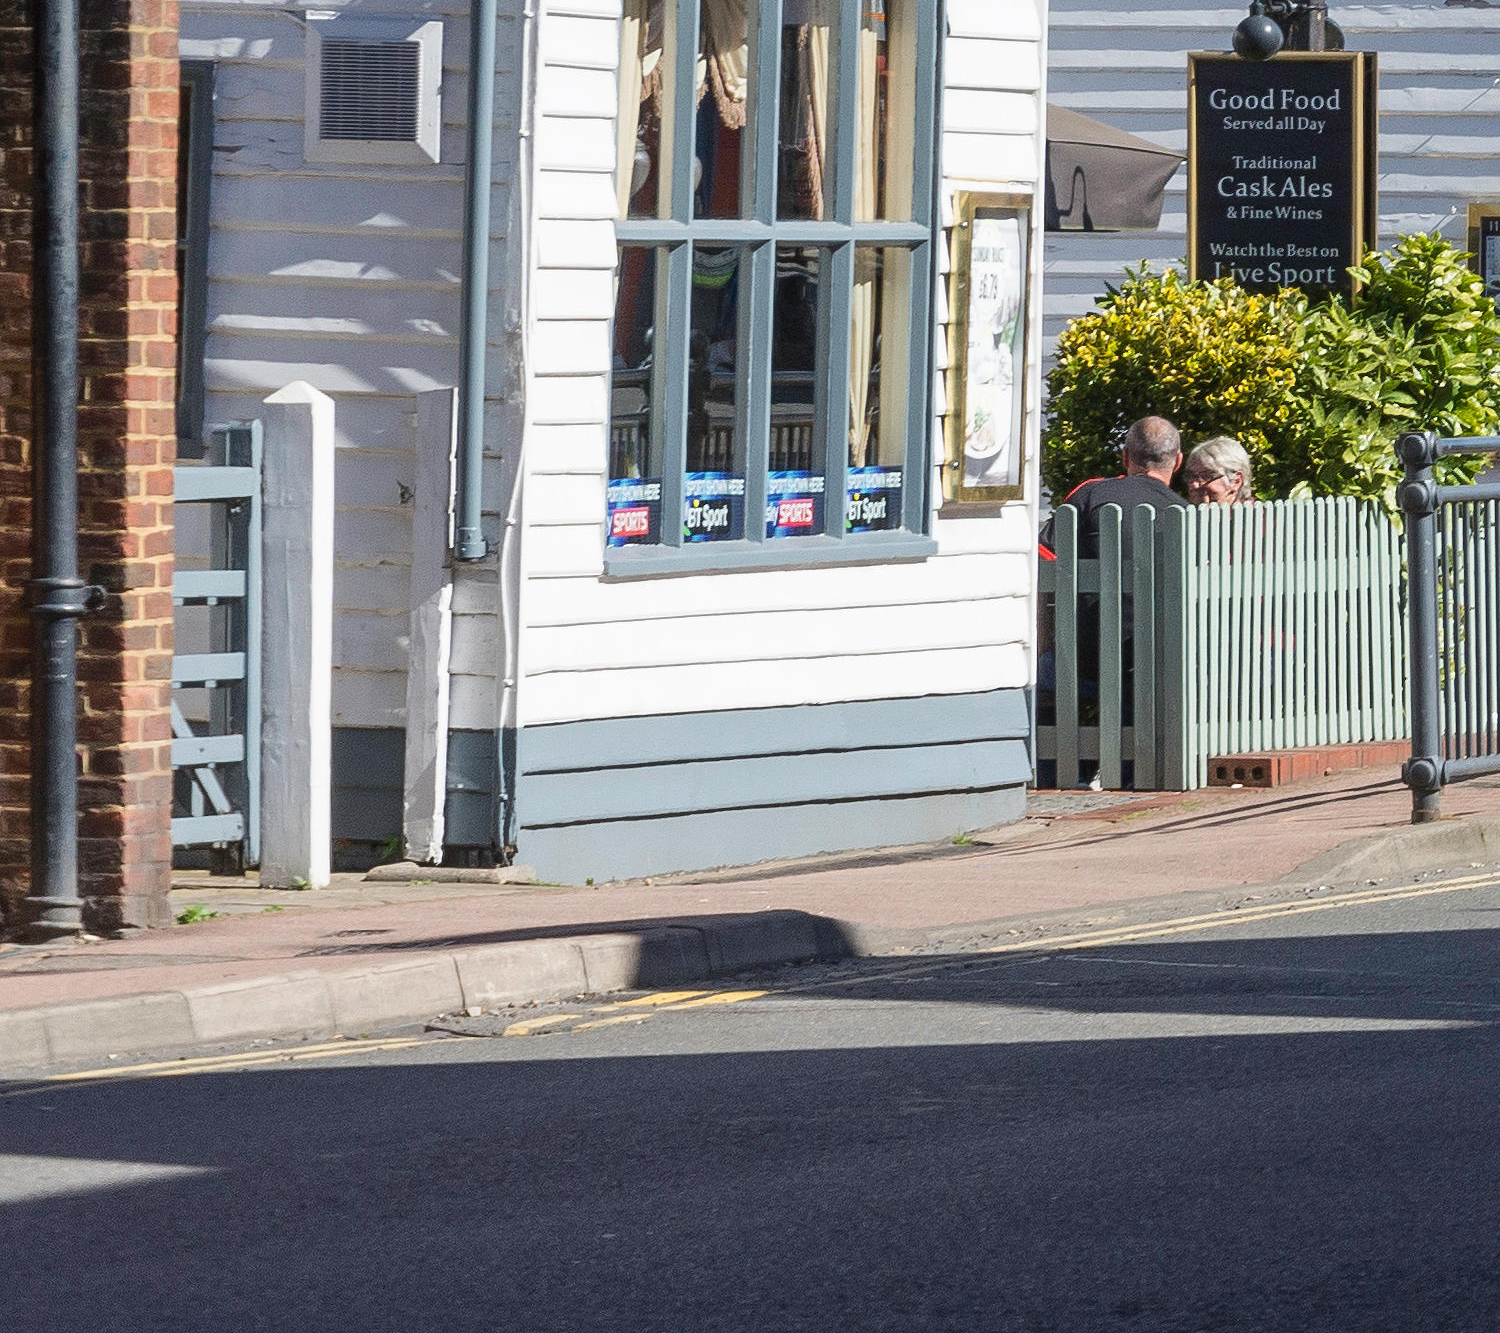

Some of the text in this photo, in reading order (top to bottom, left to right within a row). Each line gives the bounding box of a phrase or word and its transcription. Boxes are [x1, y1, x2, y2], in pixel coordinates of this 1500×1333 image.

[1209, 88, 1341, 110] Good Food
[1223, 116, 1326, 133] Served all Day
[1232, 155, 1317, 169] Traditional
[1217, 176, 1333, 198] Cask Ales
[1226, 205, 1323, 219] & Fine Wines
[1489, 221, 1500, 232] 11
[1210, 243, 1339, 258] Watch the Best on
[1267, 262, 1336, 288] Sport
[613, 510, 648, 533] SPORTS
[687, 503, 729, 532] BT Sport
[779, 501, 812, 524] SPORTS
[862, 497, 886, 524] Sport
